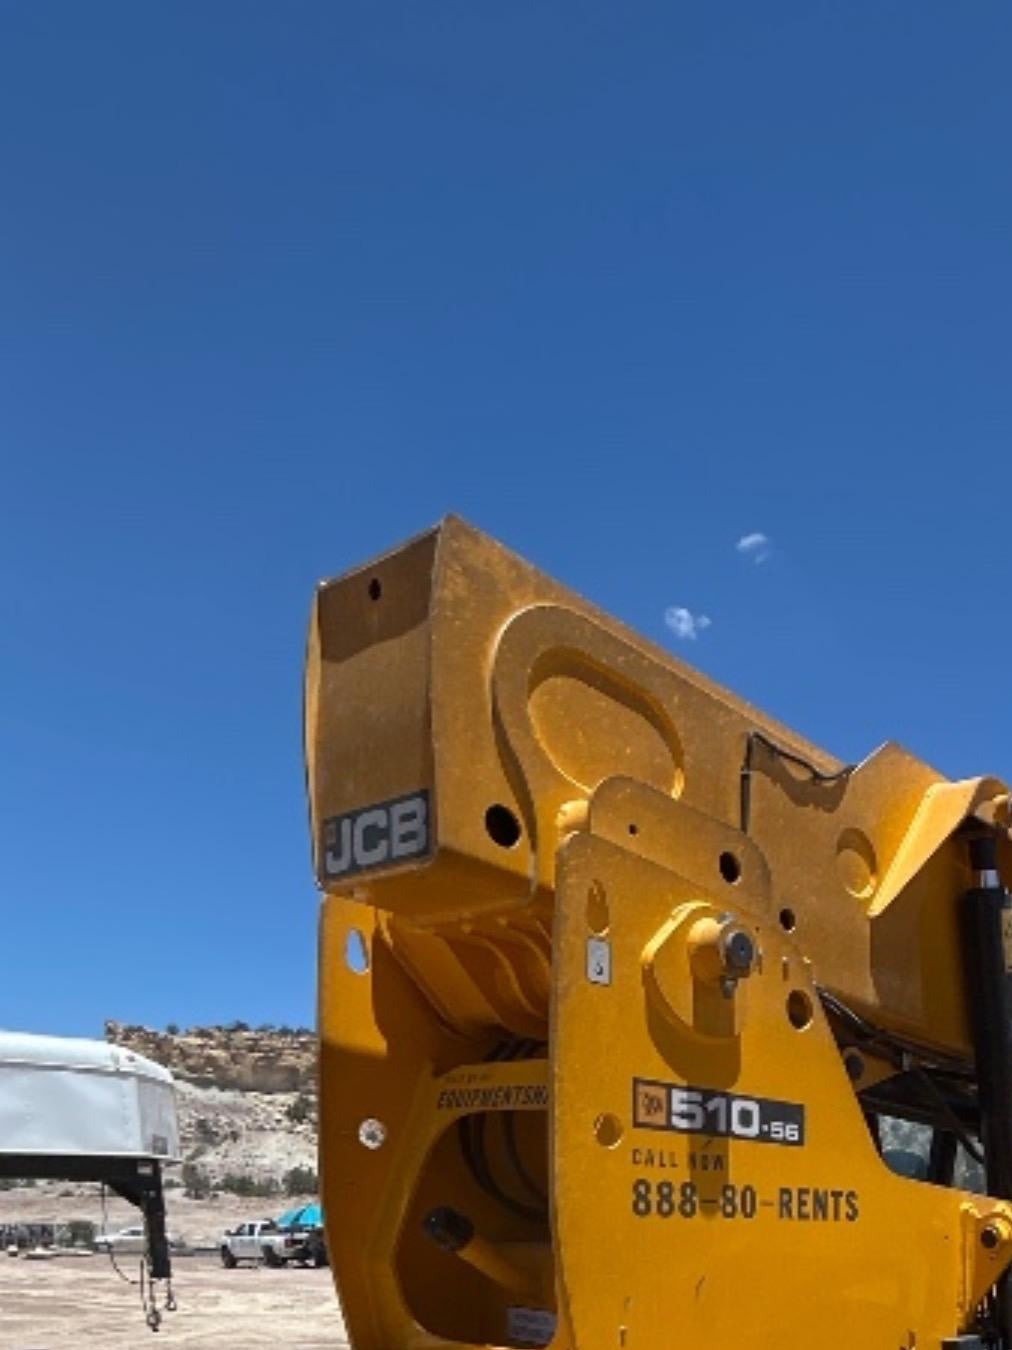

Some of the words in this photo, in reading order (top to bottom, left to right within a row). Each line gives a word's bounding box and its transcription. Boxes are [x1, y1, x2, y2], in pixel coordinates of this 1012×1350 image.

[324, 797, 427, 875] JCB
[437, 1083, 549, 1110] EQUIPMENTSH
[632, 1148, 679, 1168] CALL
[689, 1152, 725, 1171] NOW
[632, 1178, 860, 1222] 888-80-RENTS
